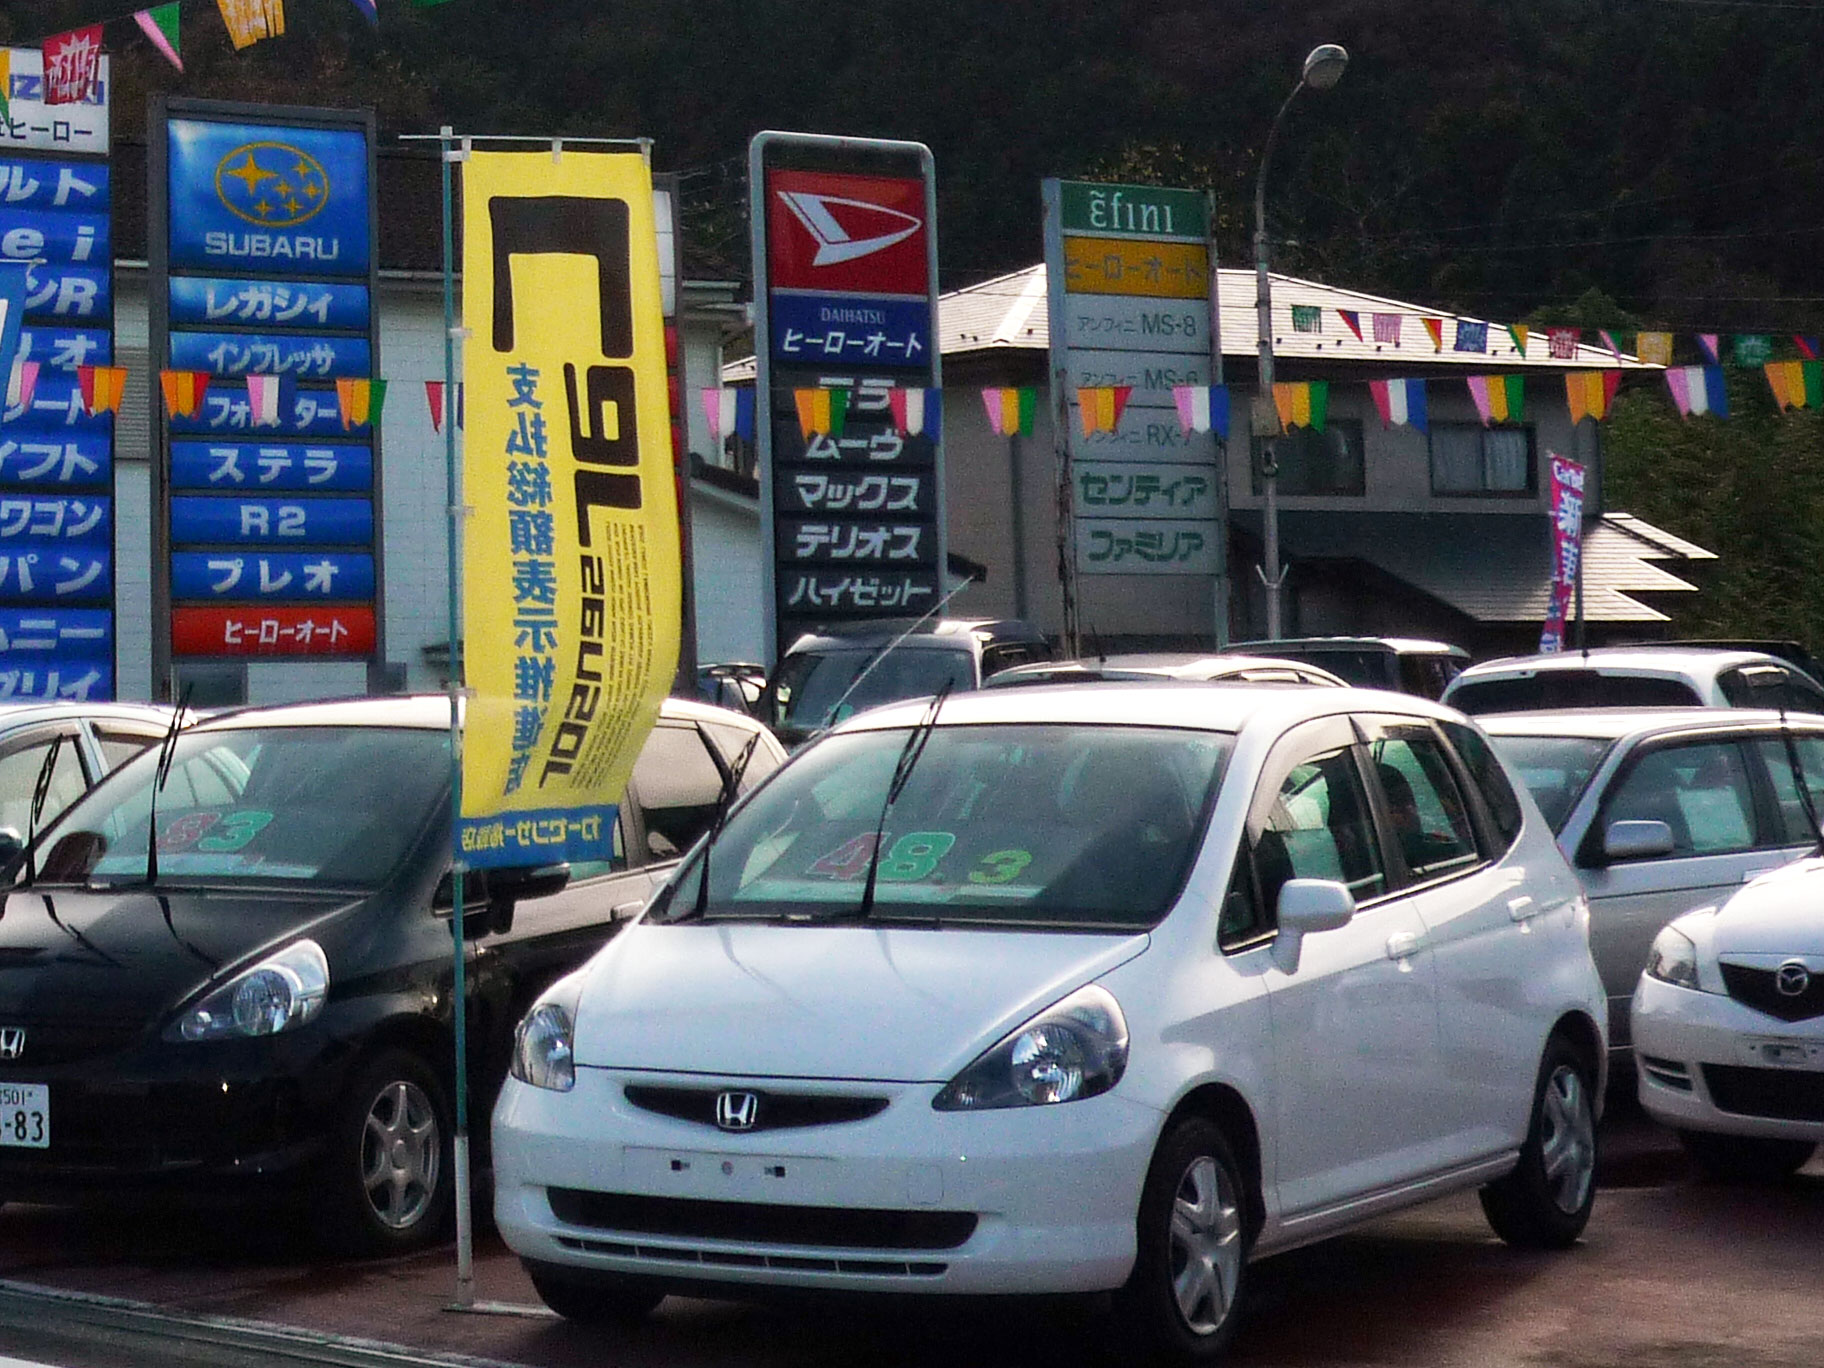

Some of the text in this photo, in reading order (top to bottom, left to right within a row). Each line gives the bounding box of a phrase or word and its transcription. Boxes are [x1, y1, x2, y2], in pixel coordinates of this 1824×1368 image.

[205, 232, 339, 261] SUBARU
[820, 307, 886, 325] DAIHATSU
[1142, 313, 1196, 338] MS-8
[782, 328, 923, 358] ヒーローオート
[207, 396, 338, 430] フォター
[208, 447, 338, 483] ステラ
[795, 474, 919, 510] マックス
[1079, 471, 1209, 507] センティア
[240, 505, 306, 537] R2
[795, 524, 922, 559] テリオス
[1088, 529, 1204, 562] ファミリア
[207, 558, 339, 594] プレオ
[788, 576, 933, 607] ハイゼット
[223, 618, 348, 646] ヒーローオート
